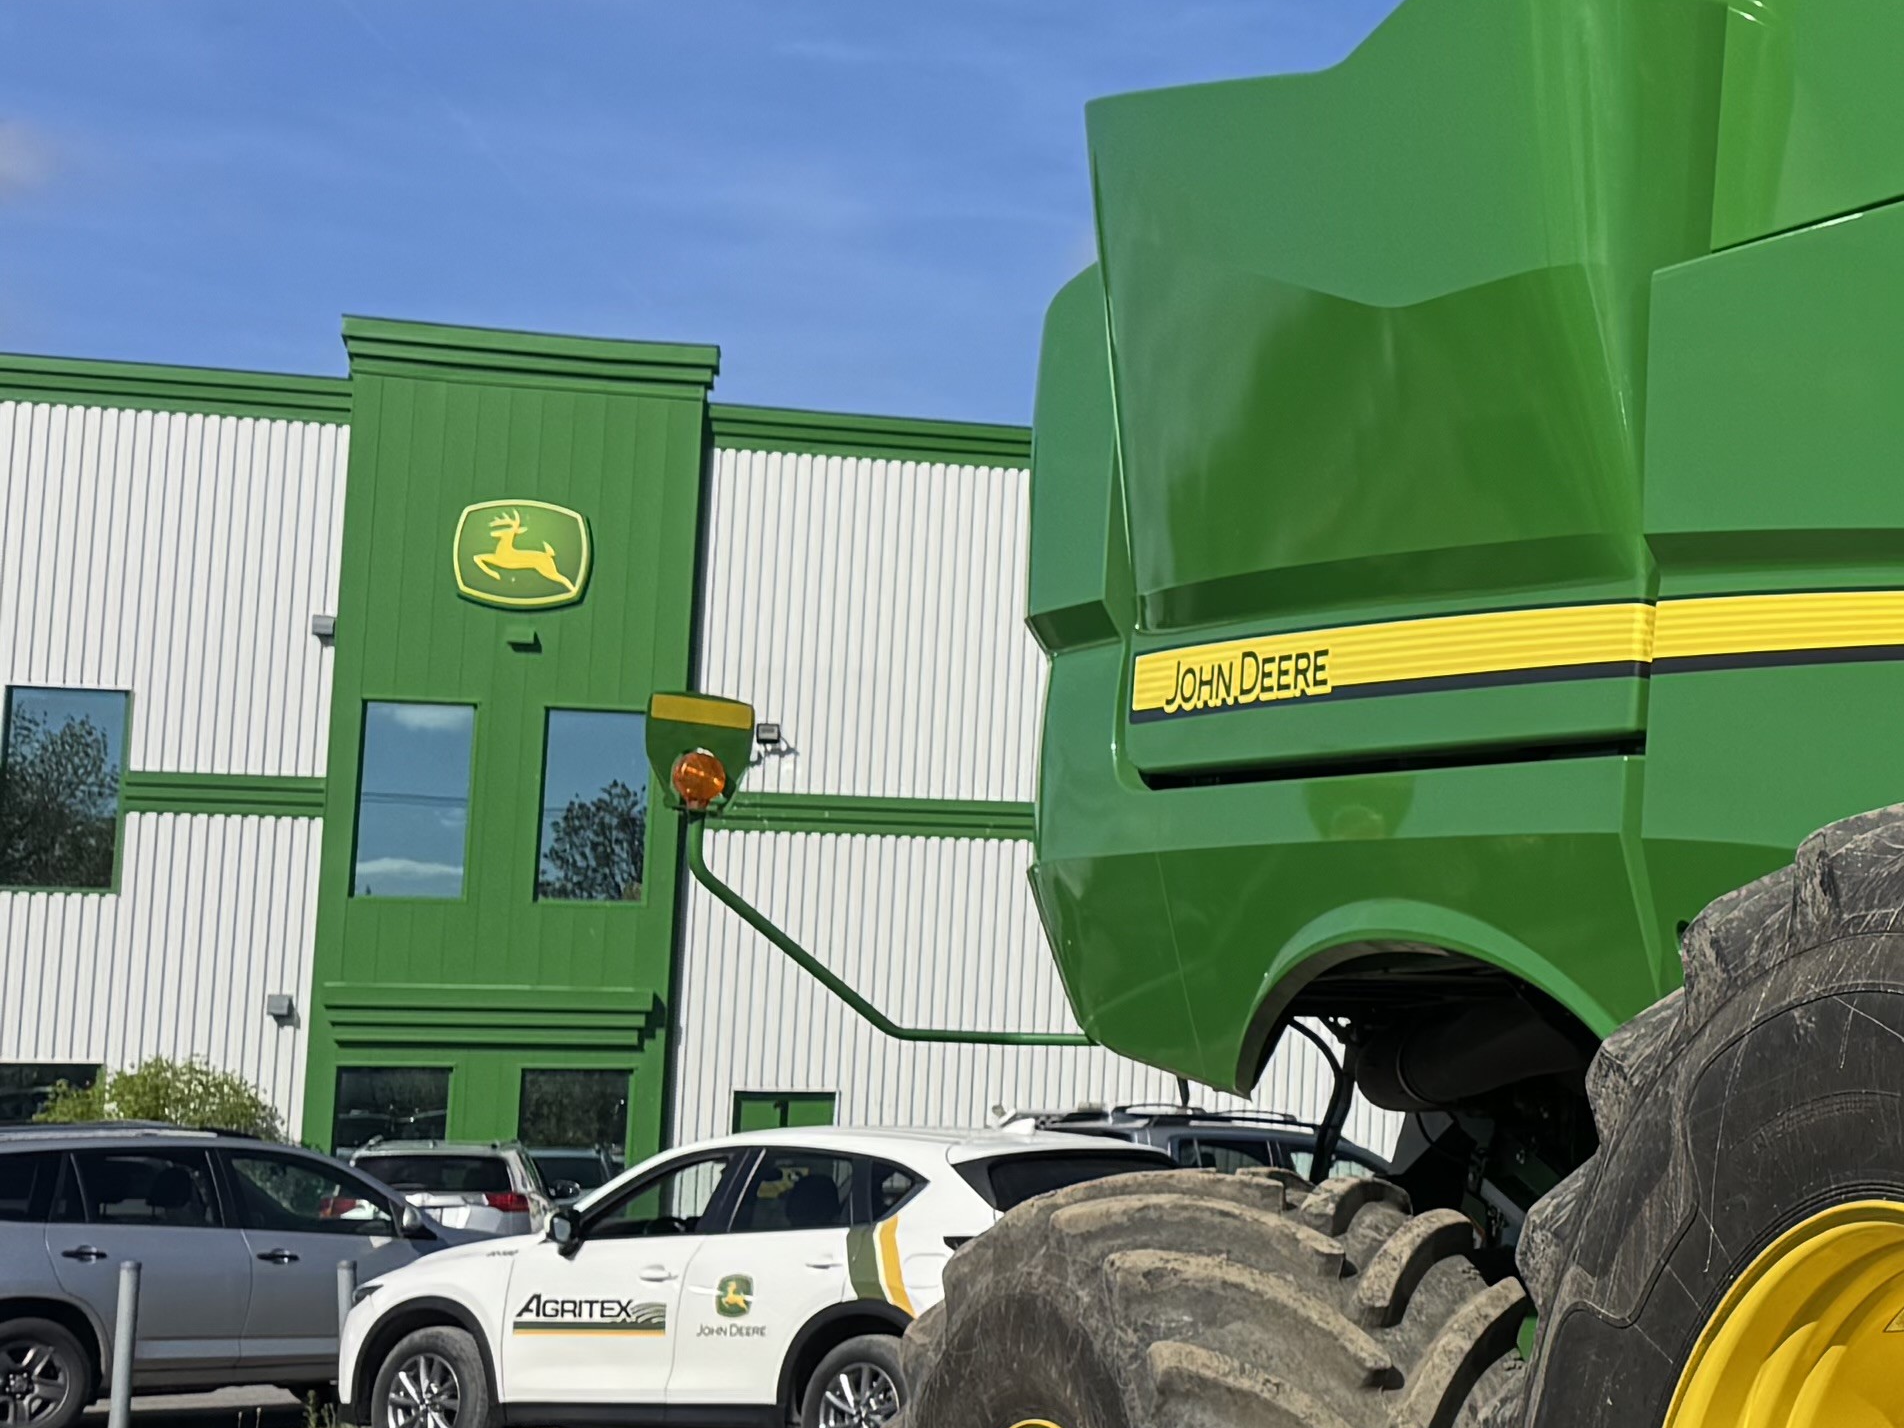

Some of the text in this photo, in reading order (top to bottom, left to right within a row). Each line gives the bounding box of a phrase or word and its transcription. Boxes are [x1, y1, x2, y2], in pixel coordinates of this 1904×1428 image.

[1165, 649, 1329, 705] JOHN DEERE
[516, 1293, 634, 1319] AGRITEX
[696, 1323, 767, 1337] JOHN DEERE
